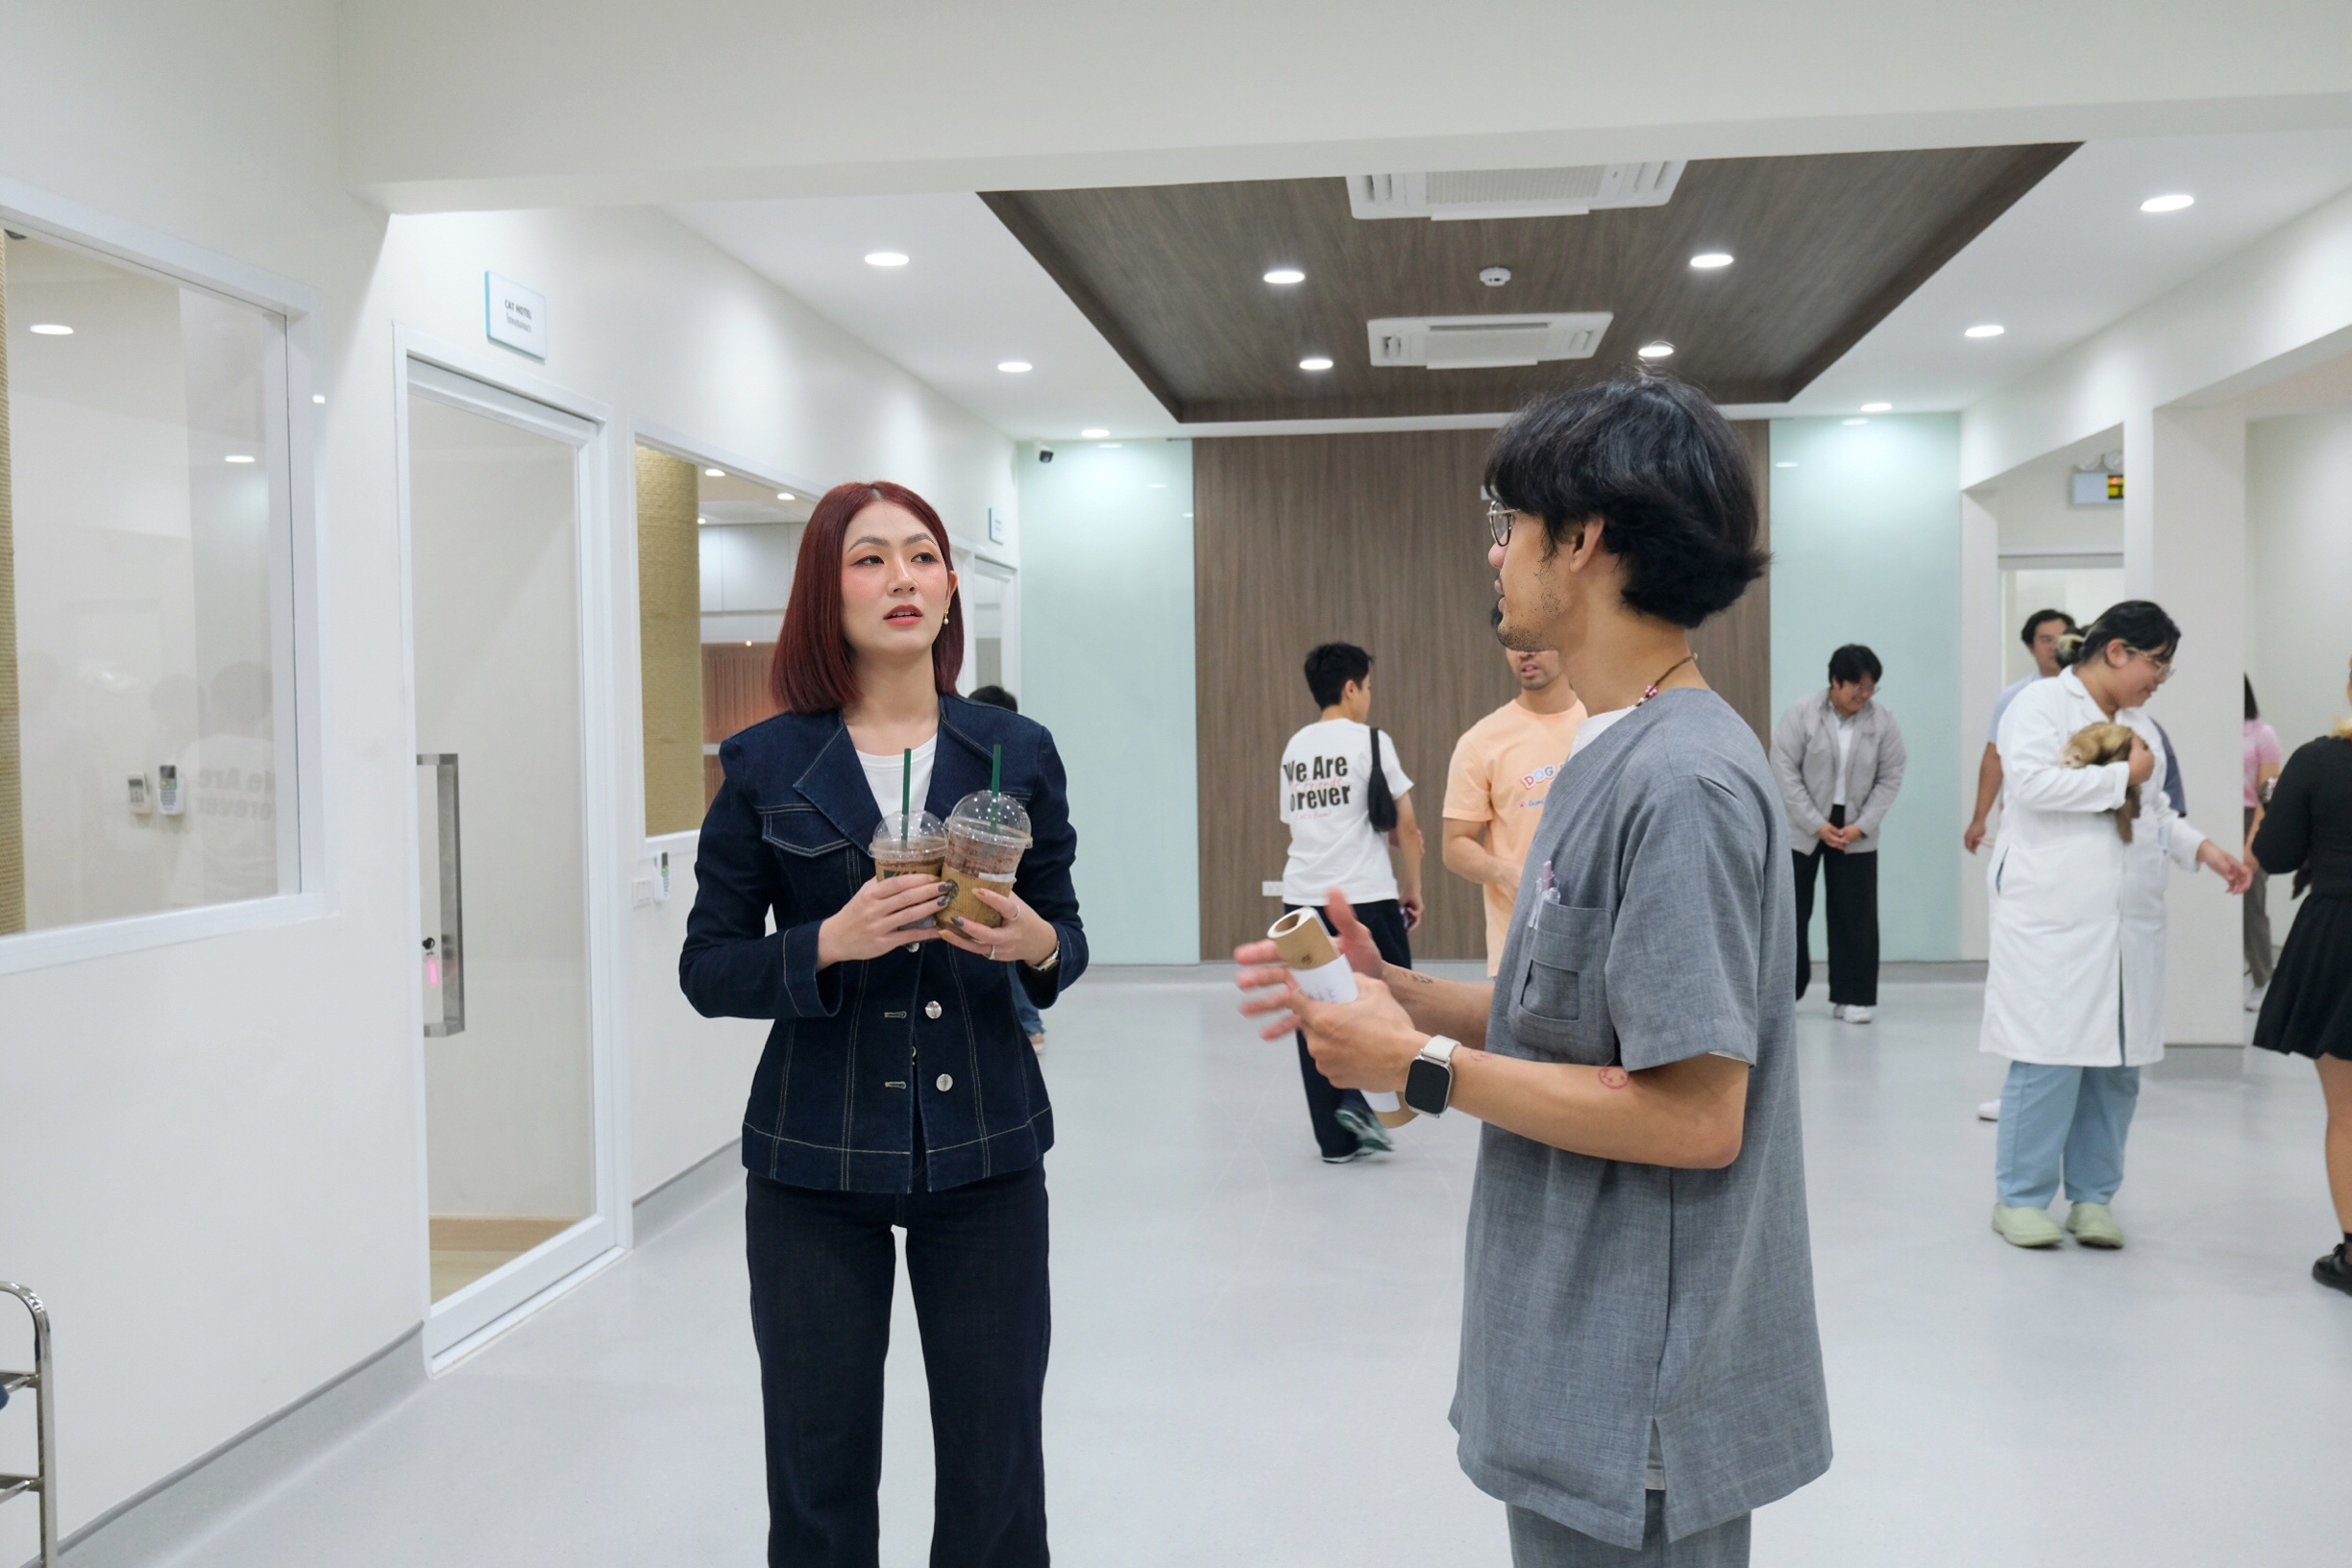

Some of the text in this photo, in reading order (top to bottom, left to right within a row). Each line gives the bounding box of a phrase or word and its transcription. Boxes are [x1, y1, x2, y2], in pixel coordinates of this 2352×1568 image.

[504, 300, 531, 319] CAT HOTEL
[1312, 756, 1348, 780] Are
[1524, 767, 1554, 785] DOG
[1290, 785, 1350, 812] orever
